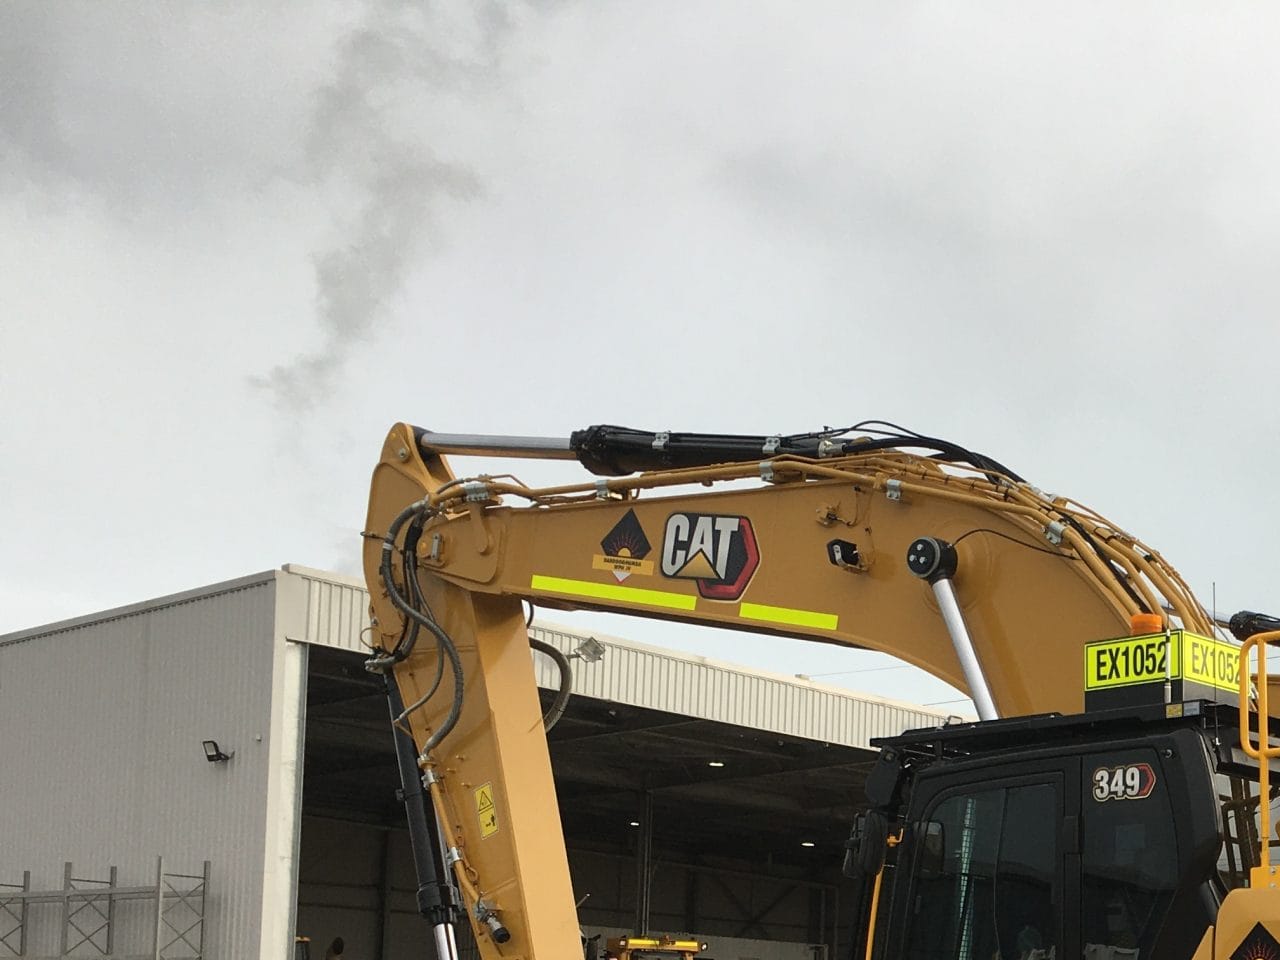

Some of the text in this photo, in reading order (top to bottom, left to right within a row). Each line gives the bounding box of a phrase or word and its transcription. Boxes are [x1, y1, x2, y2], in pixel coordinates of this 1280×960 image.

[662, 514, 739, 579] CAT
[1096, 641, 1167, 681] EX1052
[1095, 766, 1140, 799] 349
